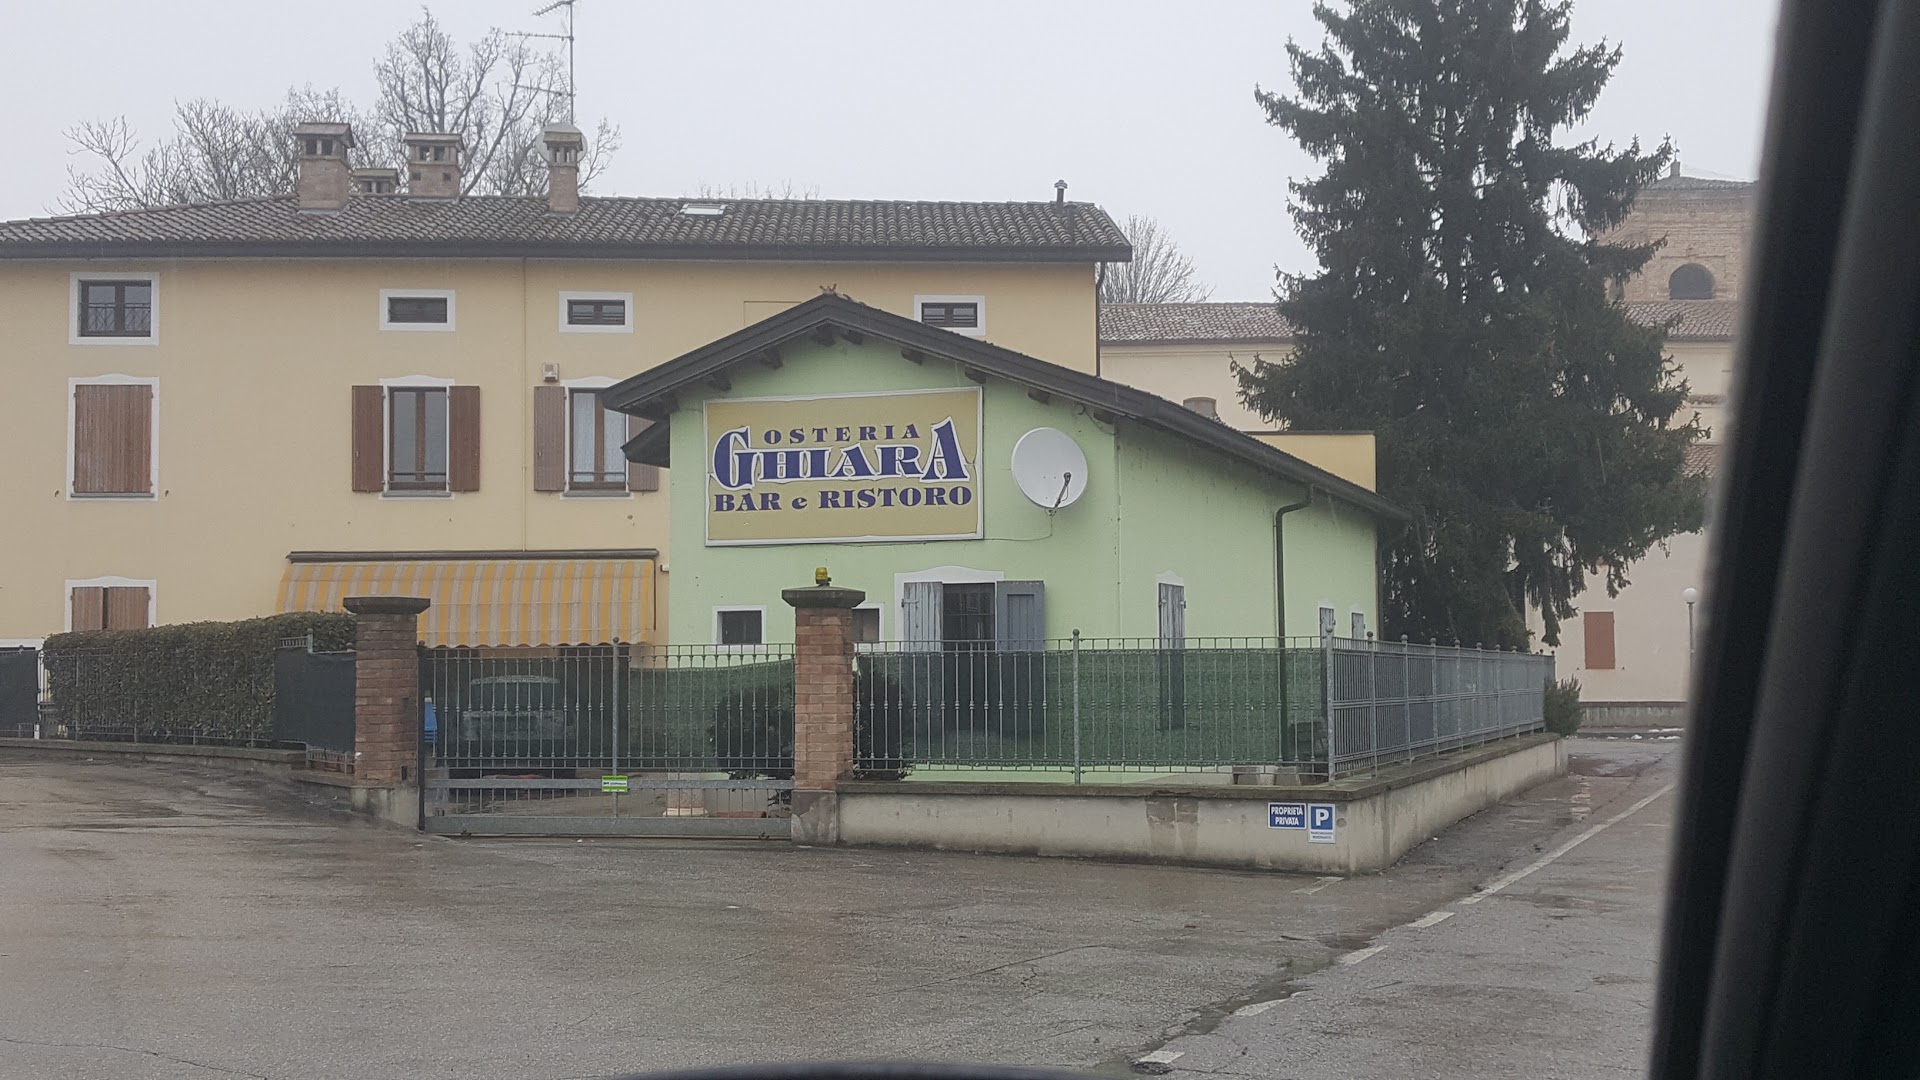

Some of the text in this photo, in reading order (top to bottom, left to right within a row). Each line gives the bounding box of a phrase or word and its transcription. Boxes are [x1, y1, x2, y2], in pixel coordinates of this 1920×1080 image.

[764, 423, 920, 444] OSTERIA
[713, 417, 969, 489] GHIARA
[714, 486, 972, 512] BAR e RISTORO
[1275, 817, 1299, 825] PRIVATA
[1316, 809, 1329, 826] P
